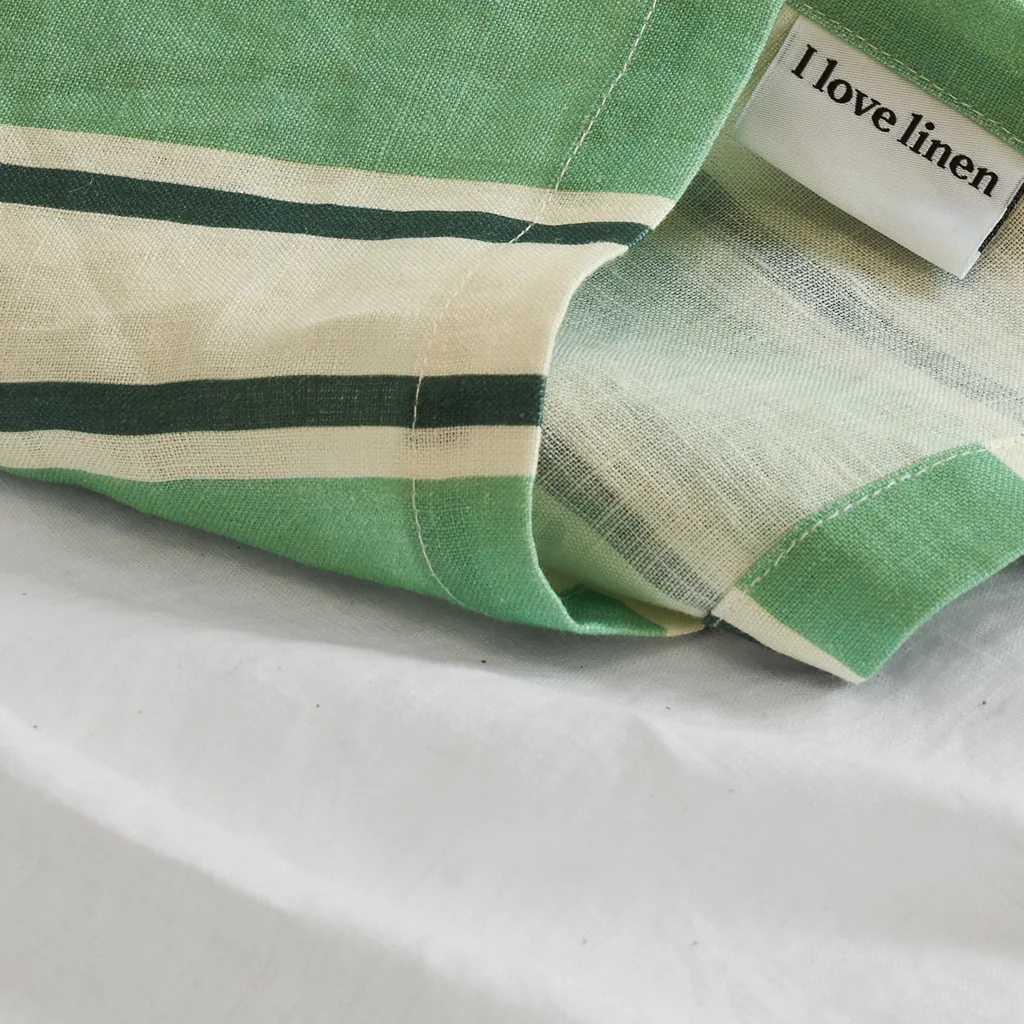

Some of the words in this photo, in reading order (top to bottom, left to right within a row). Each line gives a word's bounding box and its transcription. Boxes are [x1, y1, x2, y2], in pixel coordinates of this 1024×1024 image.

[790, 43, 818, 80] I
[812, 57, 898, 133] love
[896, 112, 1000, 198] linen
